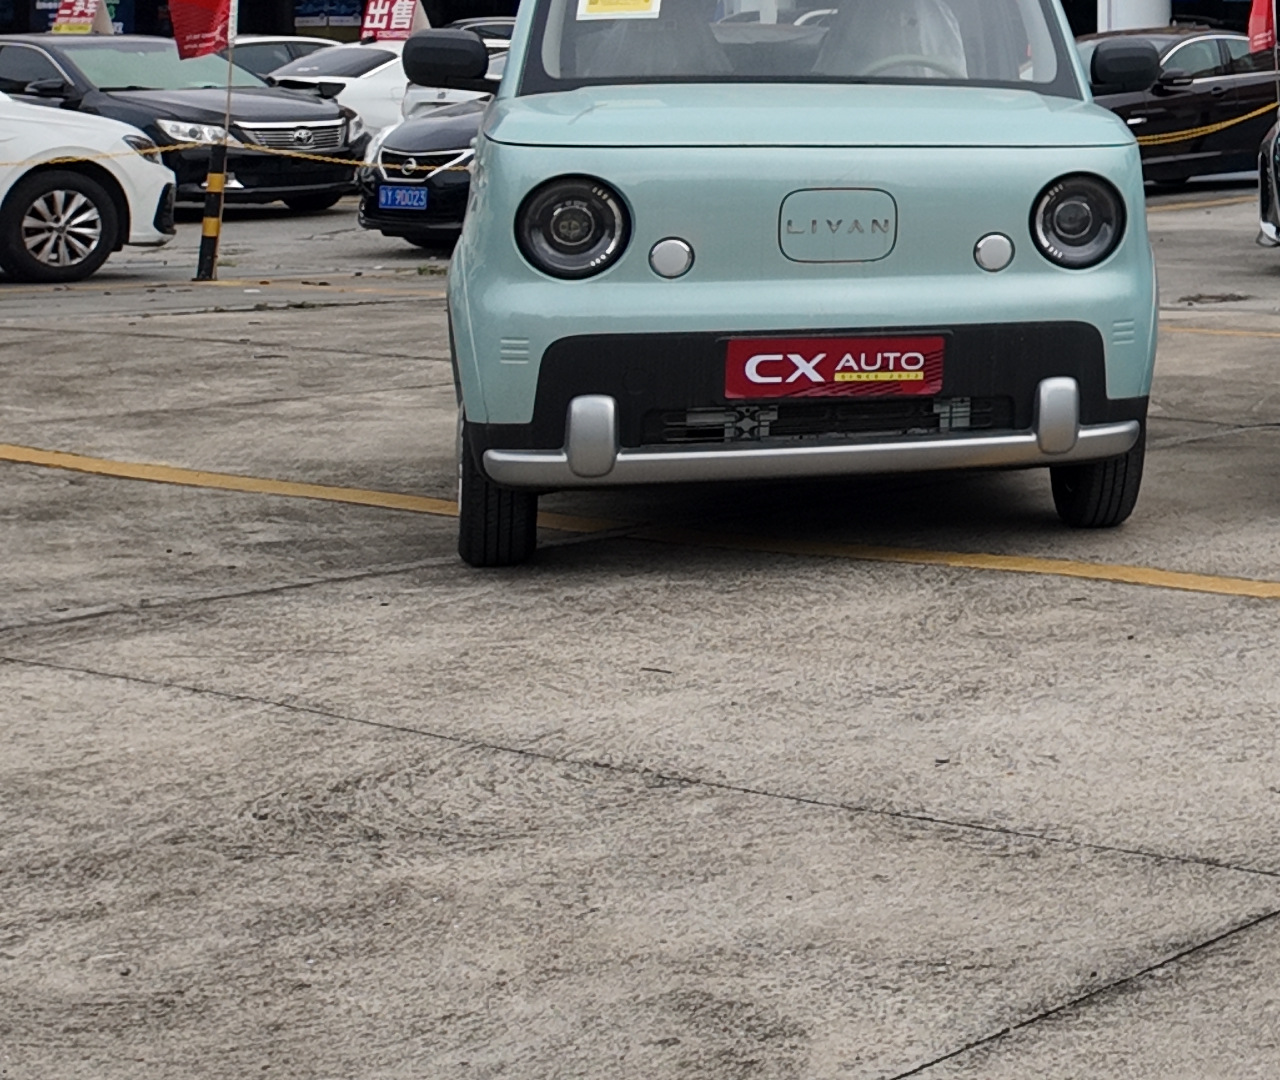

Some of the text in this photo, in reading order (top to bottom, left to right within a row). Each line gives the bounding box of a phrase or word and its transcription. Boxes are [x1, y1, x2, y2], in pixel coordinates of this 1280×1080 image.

[786, 218, 889, 235] LIVAN
[744, 351, 925, 384] CX AUTO
